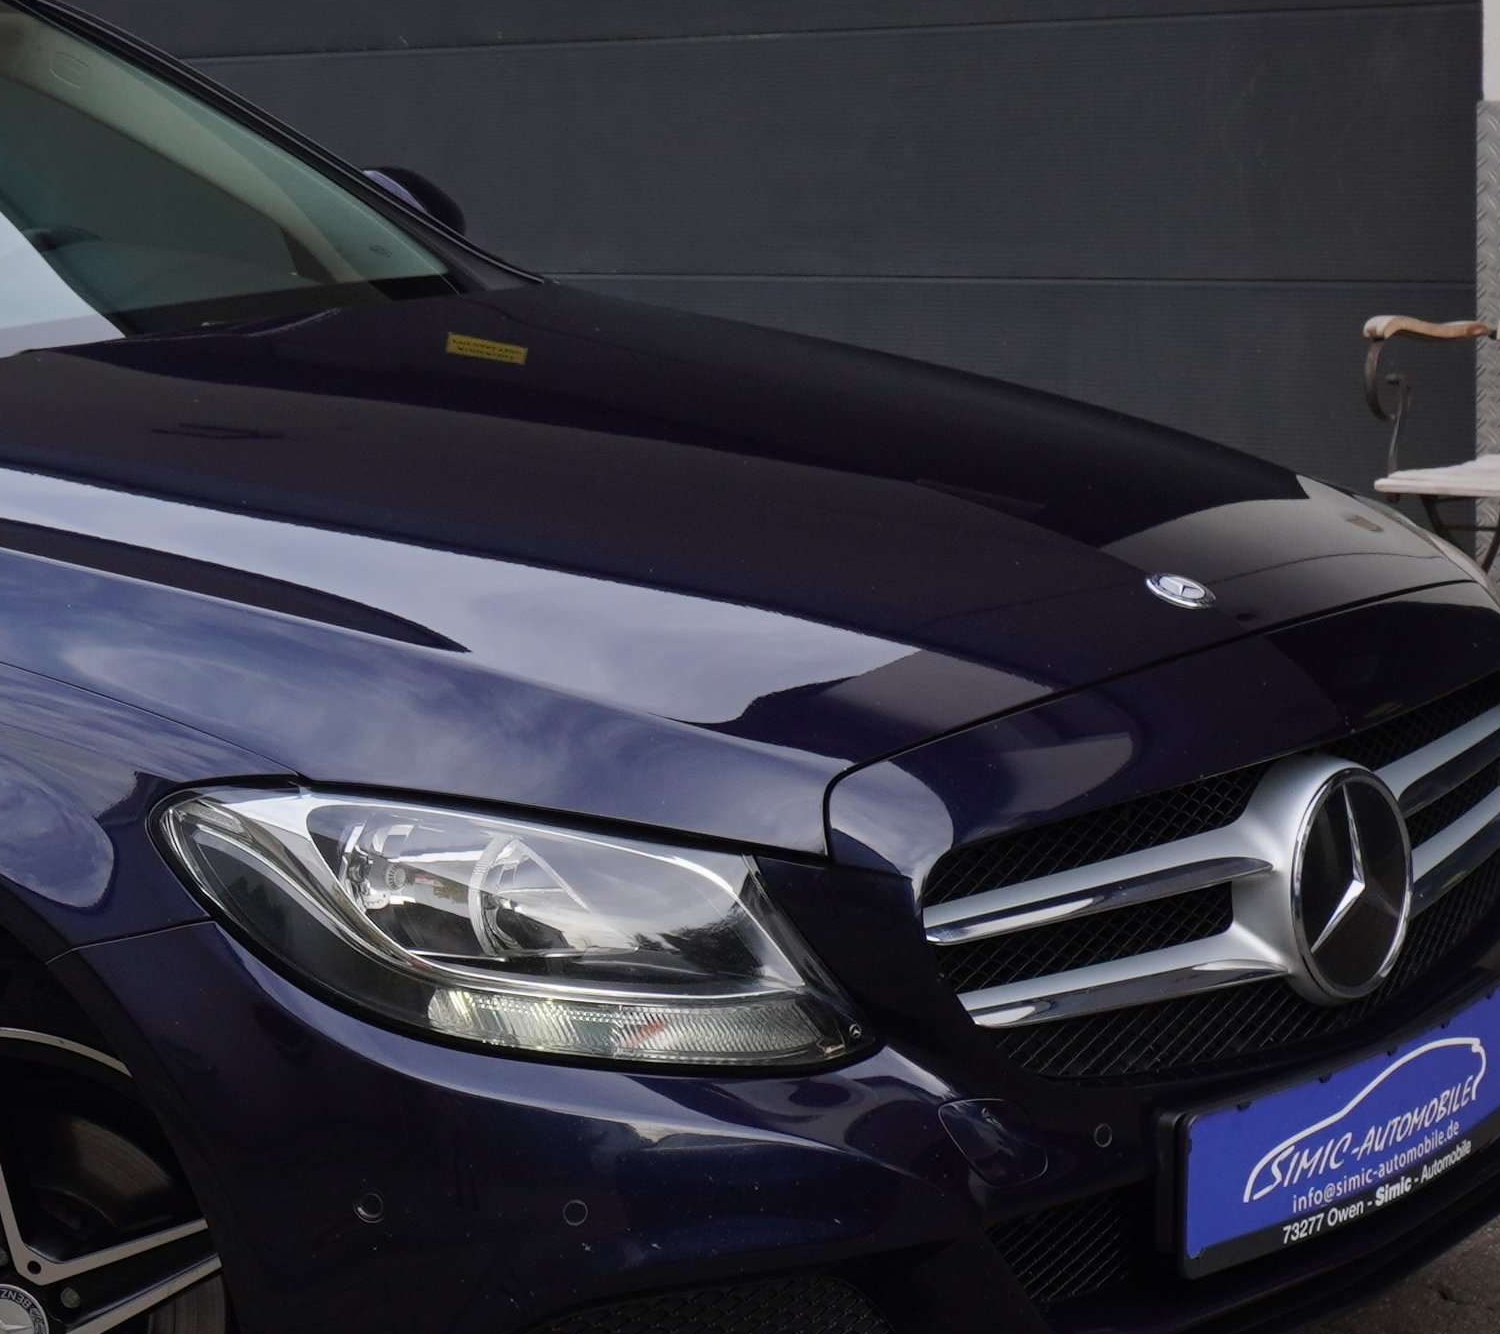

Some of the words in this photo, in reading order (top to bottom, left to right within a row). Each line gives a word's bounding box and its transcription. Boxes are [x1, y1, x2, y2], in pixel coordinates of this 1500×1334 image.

[1283, 1213, 1325, 1244] 73277
[1327, 1200, 1364, 1227] Owen
[1375, 1175, 1412, 1207] Simic
[1421, 1138, 1472, 1181] Automobile
[1292, 1119, 1461, 1214] info@simic-automobile.de
[0, 1288, 32, 1308] BENZ
